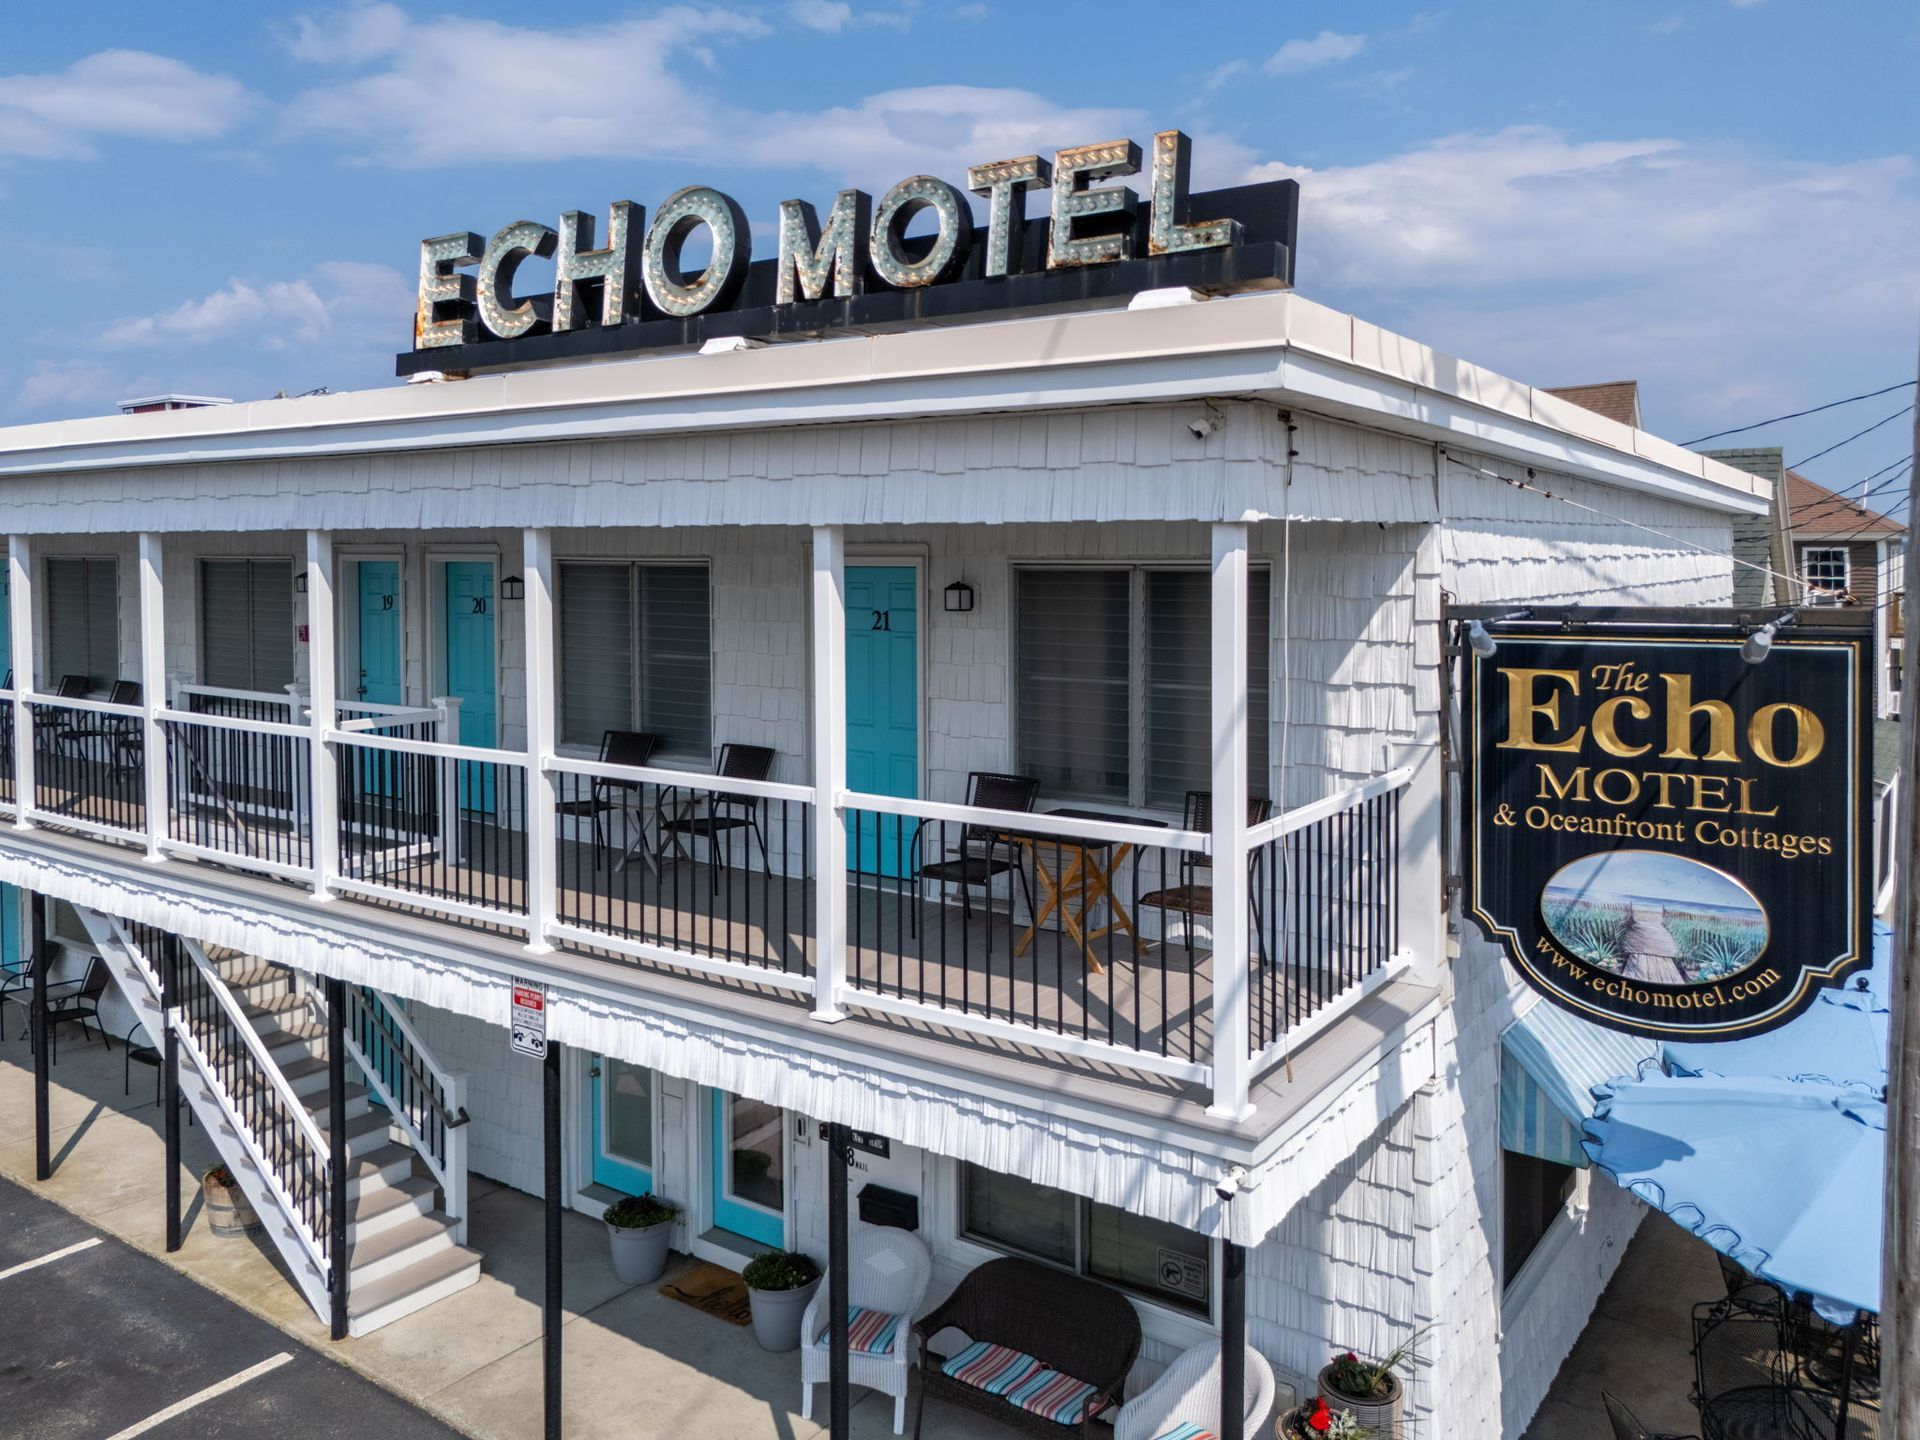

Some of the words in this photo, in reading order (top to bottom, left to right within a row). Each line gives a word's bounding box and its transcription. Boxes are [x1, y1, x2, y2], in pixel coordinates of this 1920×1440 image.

[415, 185, 751, 350] ECHO
[776, 129, 1243, 305] MOTEL
[382, 594, 393, 611] 19
[472, 597, 486, 614] 20
[871, 609, 892, 632] 21
[1591, 661, 1649, 693] The
[1495, 666, 1826, 768] Echo
[1535, 763, 1780, 817] MOTEL
[1493, 803, 1517, 828] &
[1525, 804, 1687, 843] Oceanfront
[1694, 819, 1833, 859] Cottages
[514, 977, 543, 991] WARNING
[1535, 934, 1783, 1010] www.echomotel.com
